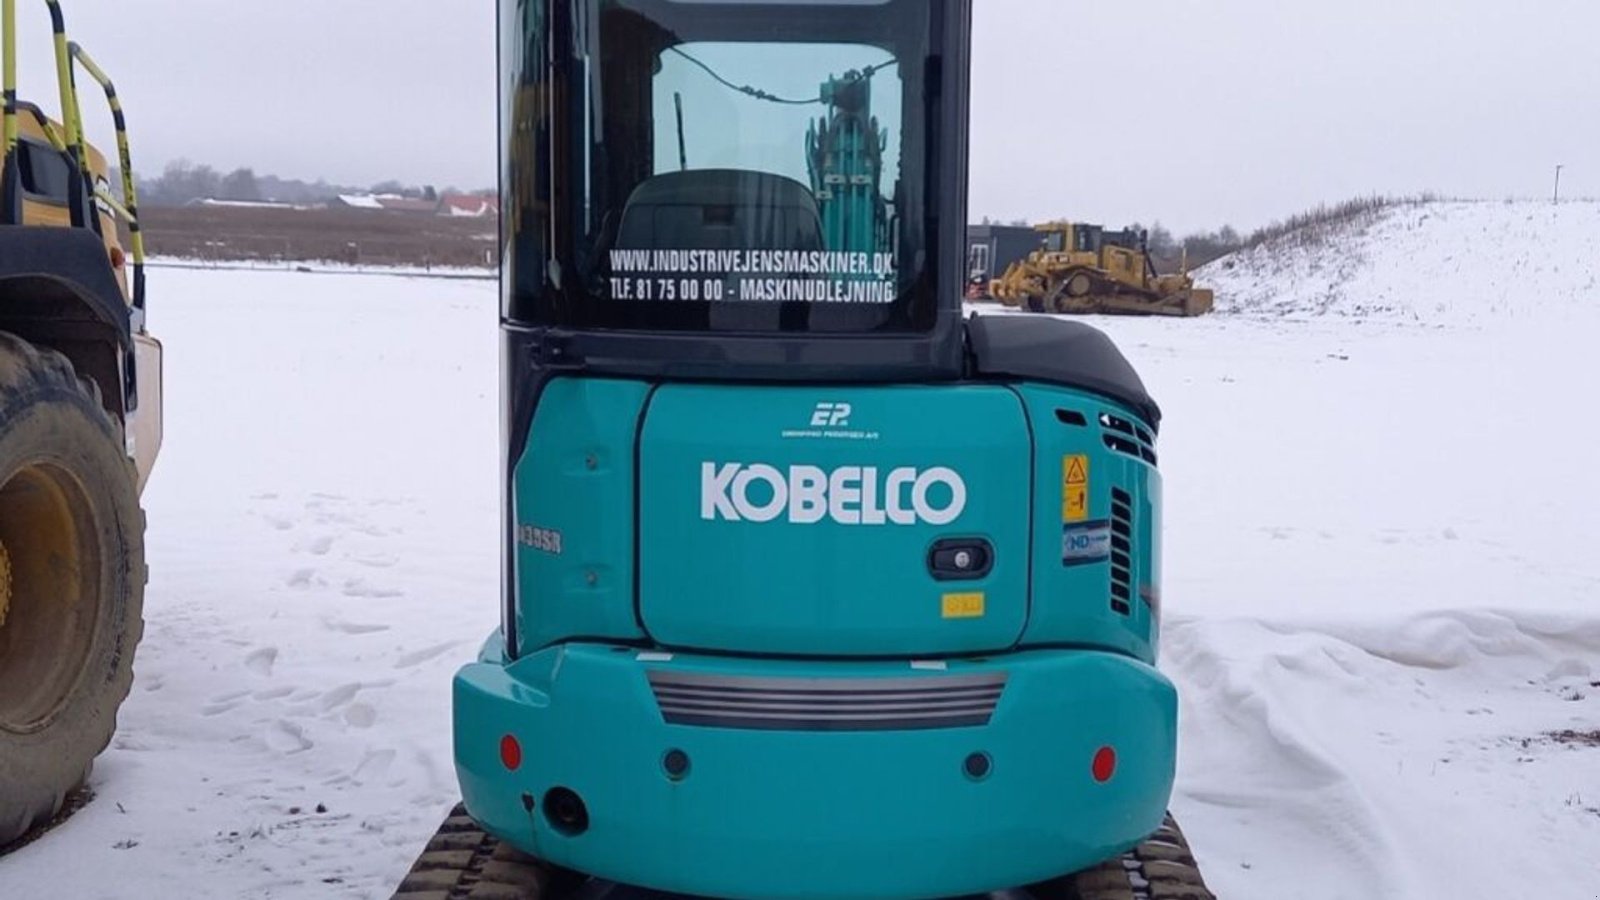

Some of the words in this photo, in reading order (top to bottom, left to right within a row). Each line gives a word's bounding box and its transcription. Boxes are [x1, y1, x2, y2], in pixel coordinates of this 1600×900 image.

[610, 278, 633, 300] TLF.
[636, 278, 652, 300] 81
[658, 279, 675, 300] 75
[680, 279, 698, 300] 00
[703, 279, 722, 301] 00
[740, 279, 893, 303] MASKINUDLEJNING
[701, 461, 967, 526] KOBELCO
